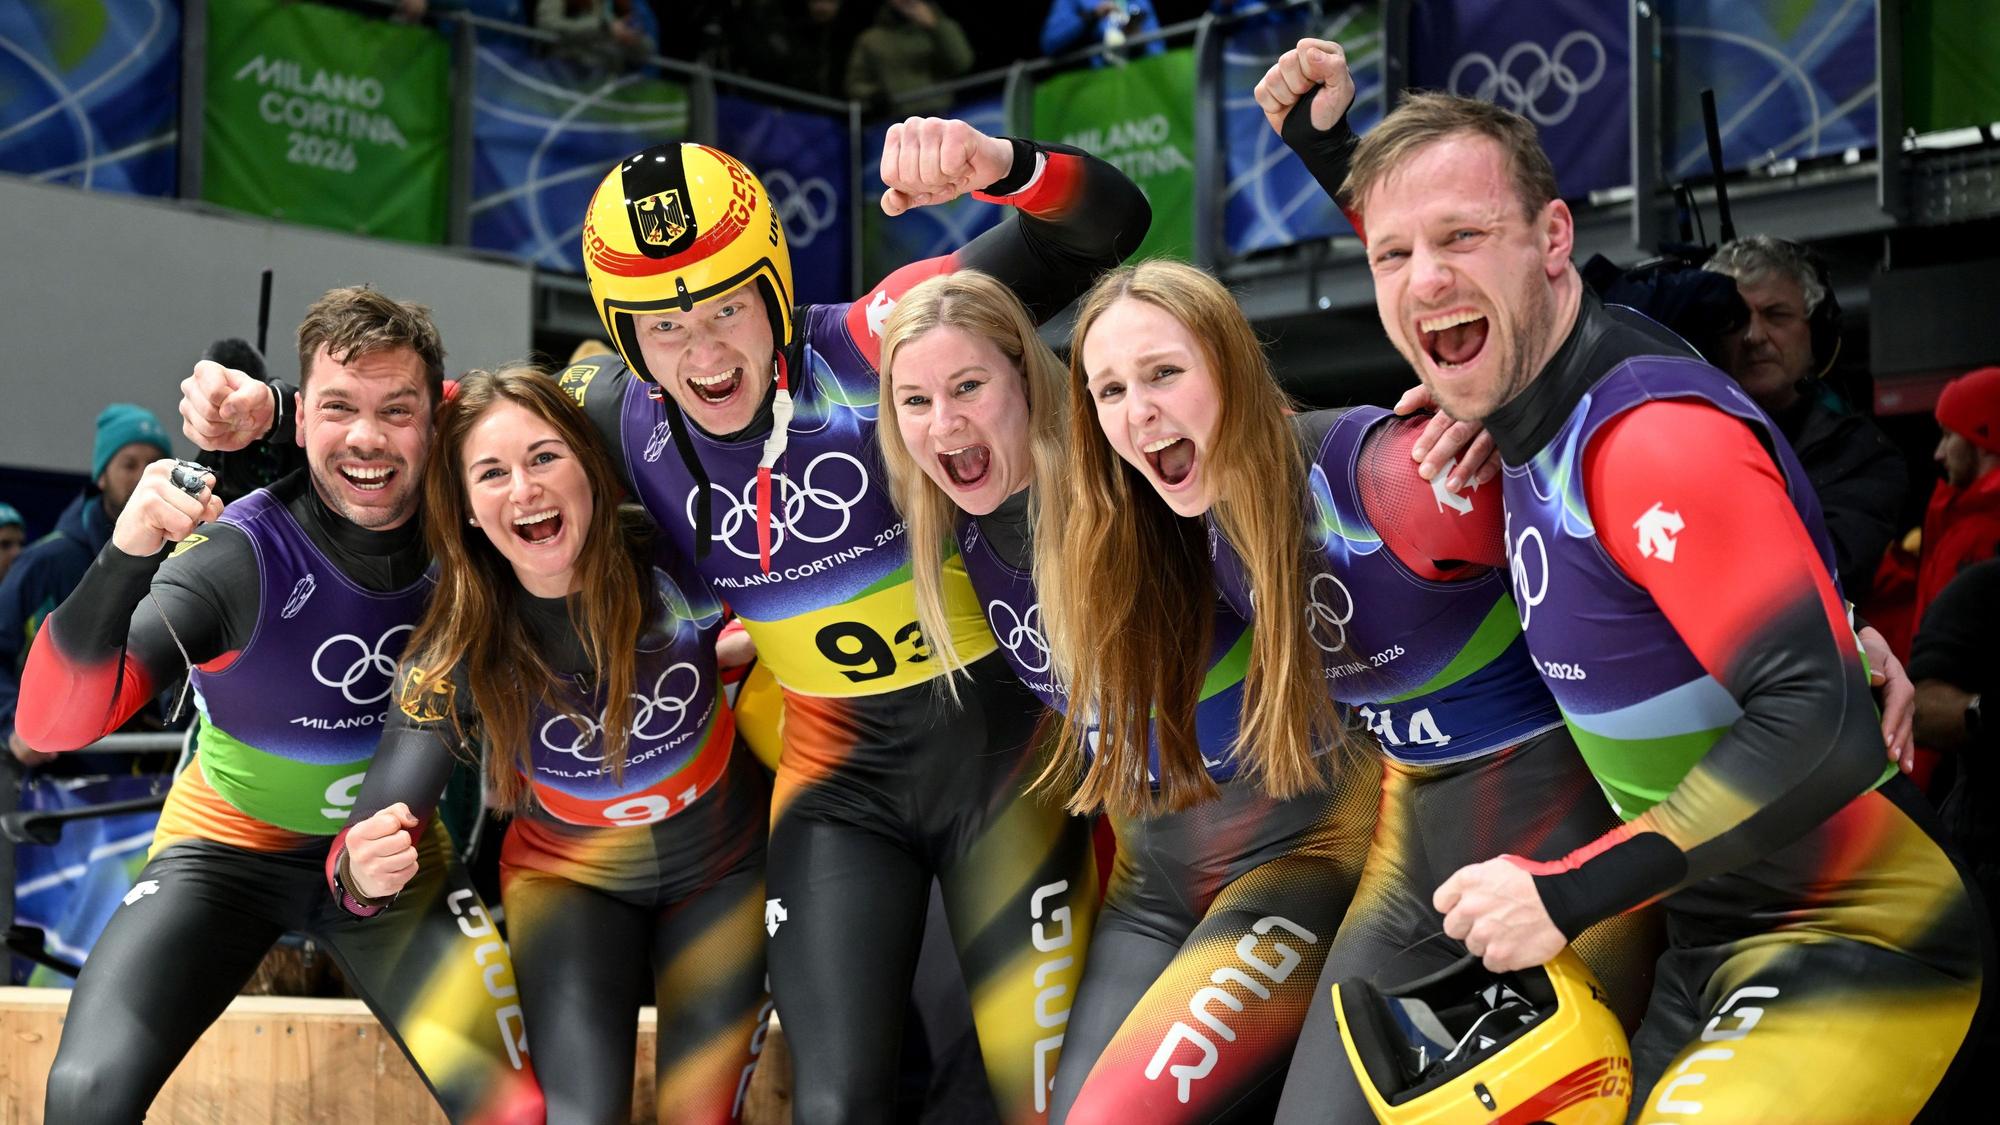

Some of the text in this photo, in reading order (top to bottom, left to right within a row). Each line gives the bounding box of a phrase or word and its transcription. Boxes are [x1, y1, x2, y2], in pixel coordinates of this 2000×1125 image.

[234, 54, 384, 109] MILANO
[258, 91, 407, 149] CORTINA
[287, 131, 357, 174] 2026
[713, 571, 782, 588] MILANO
[784, 544, 874, 581] CORTINA
[1370, 644, 1405, 667] 2026
[1544, 660, 1587, 680] 2026
[290, 716, 374, 730] MILANO
[537, 764, 615, 778] MILANO
